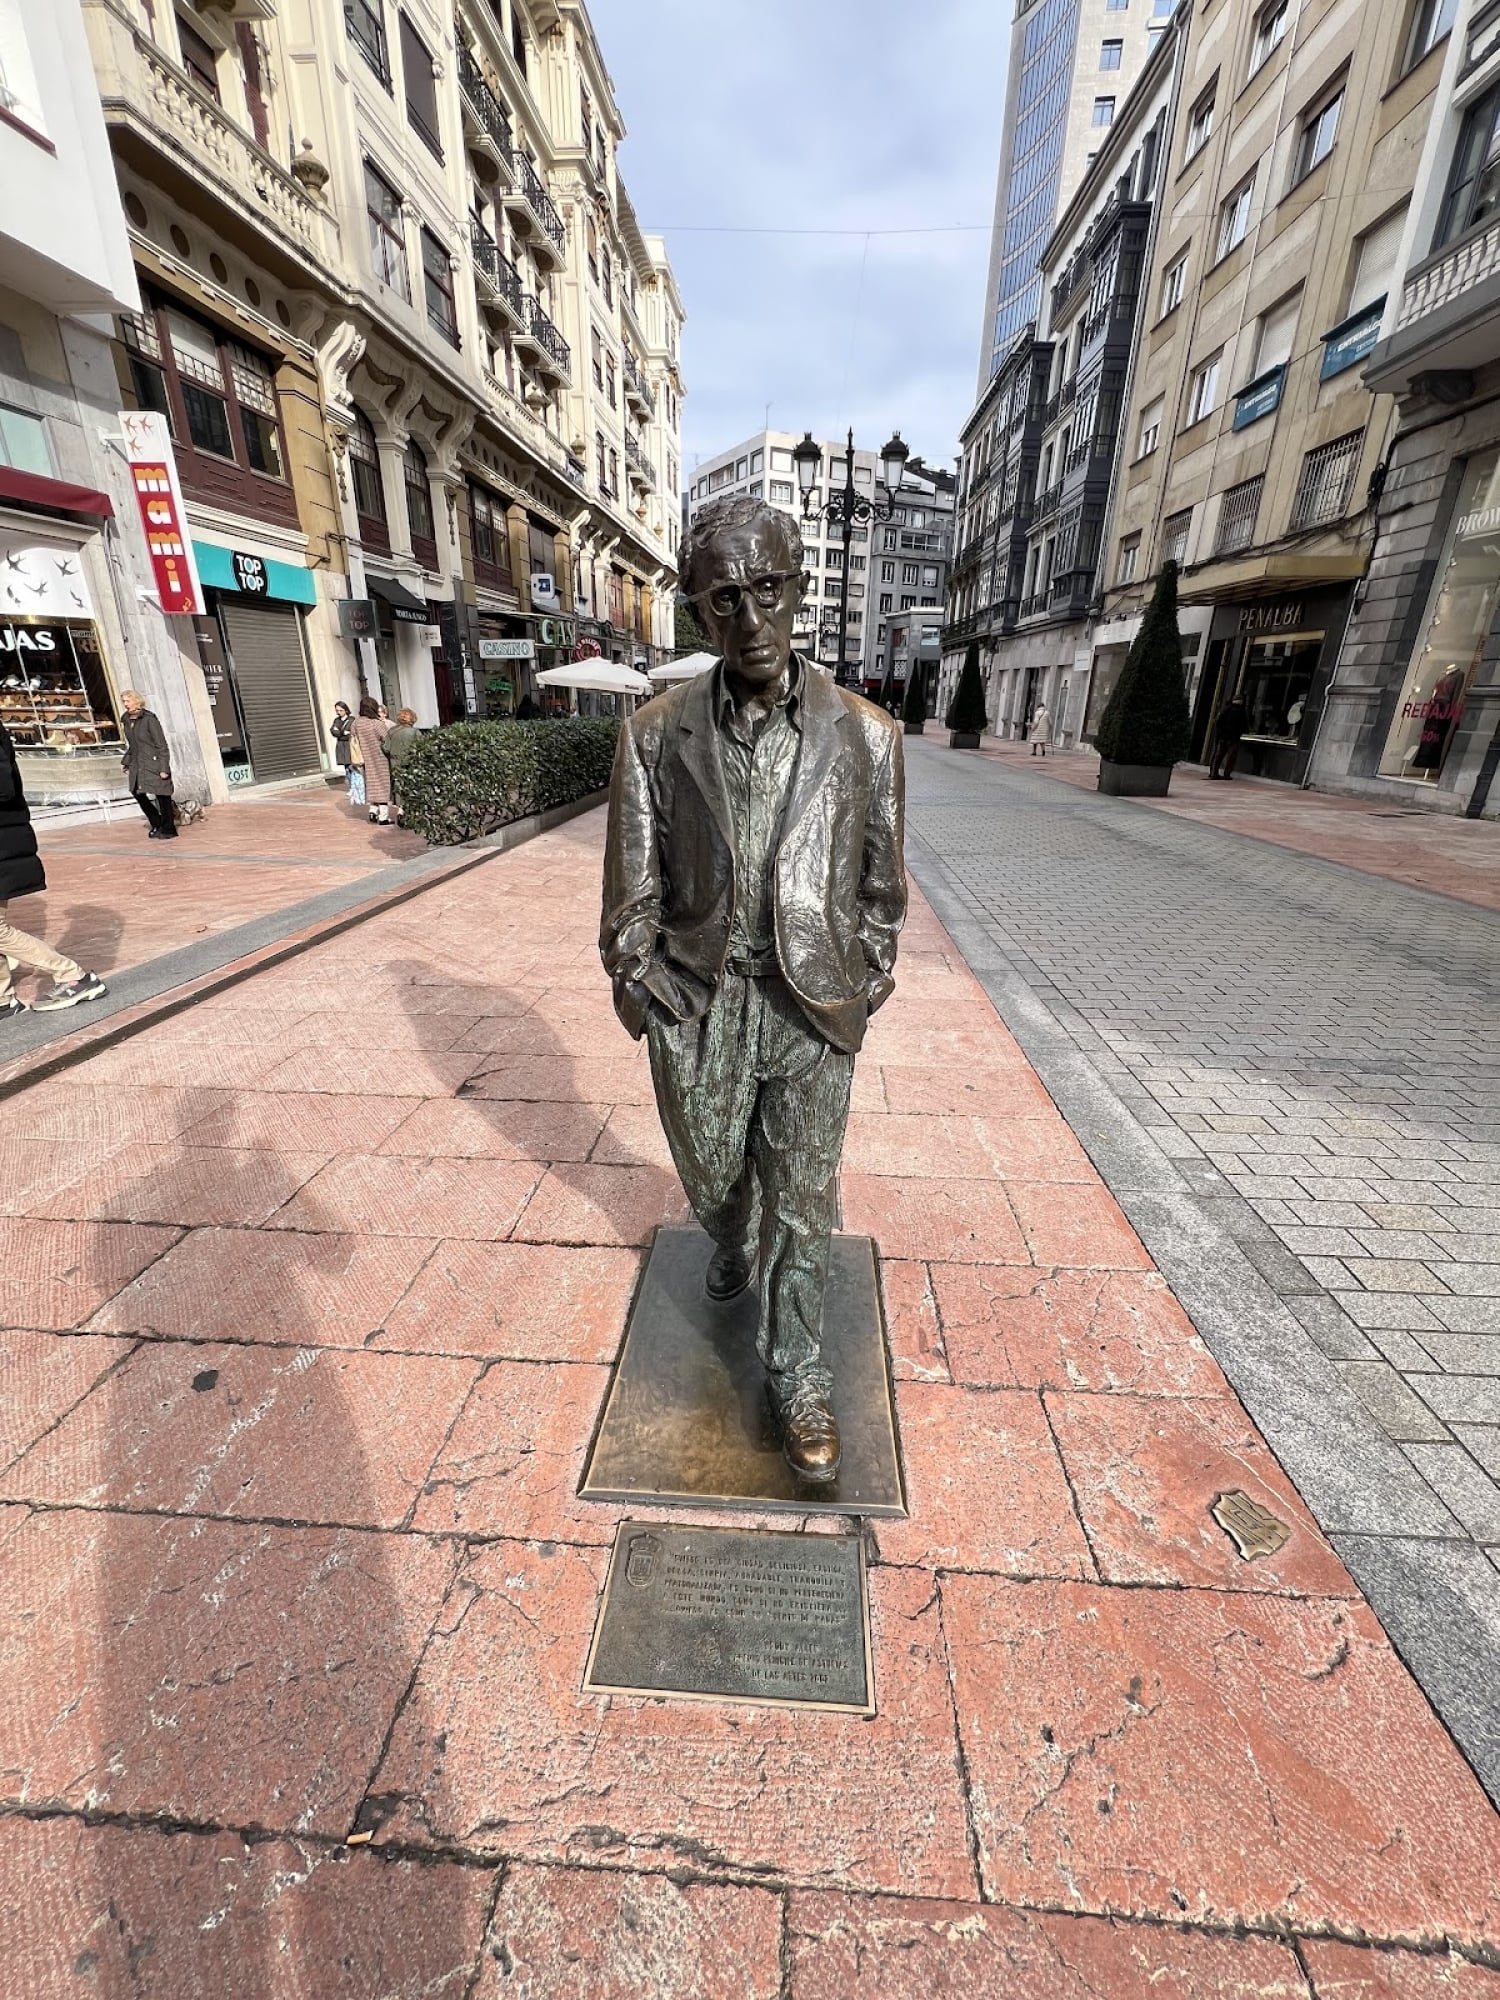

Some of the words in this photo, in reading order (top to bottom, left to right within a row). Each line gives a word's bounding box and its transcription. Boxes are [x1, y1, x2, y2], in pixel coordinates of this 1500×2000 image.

[134, 468, 186, 593] mami
[236, 554, 262, 575] TOP
[239, 572, 265, 592] TOP
[349, 620, 370, 631] TOP
[0, 629, 56, 651] JAS
[483, 641, 531, 656] CASINO
